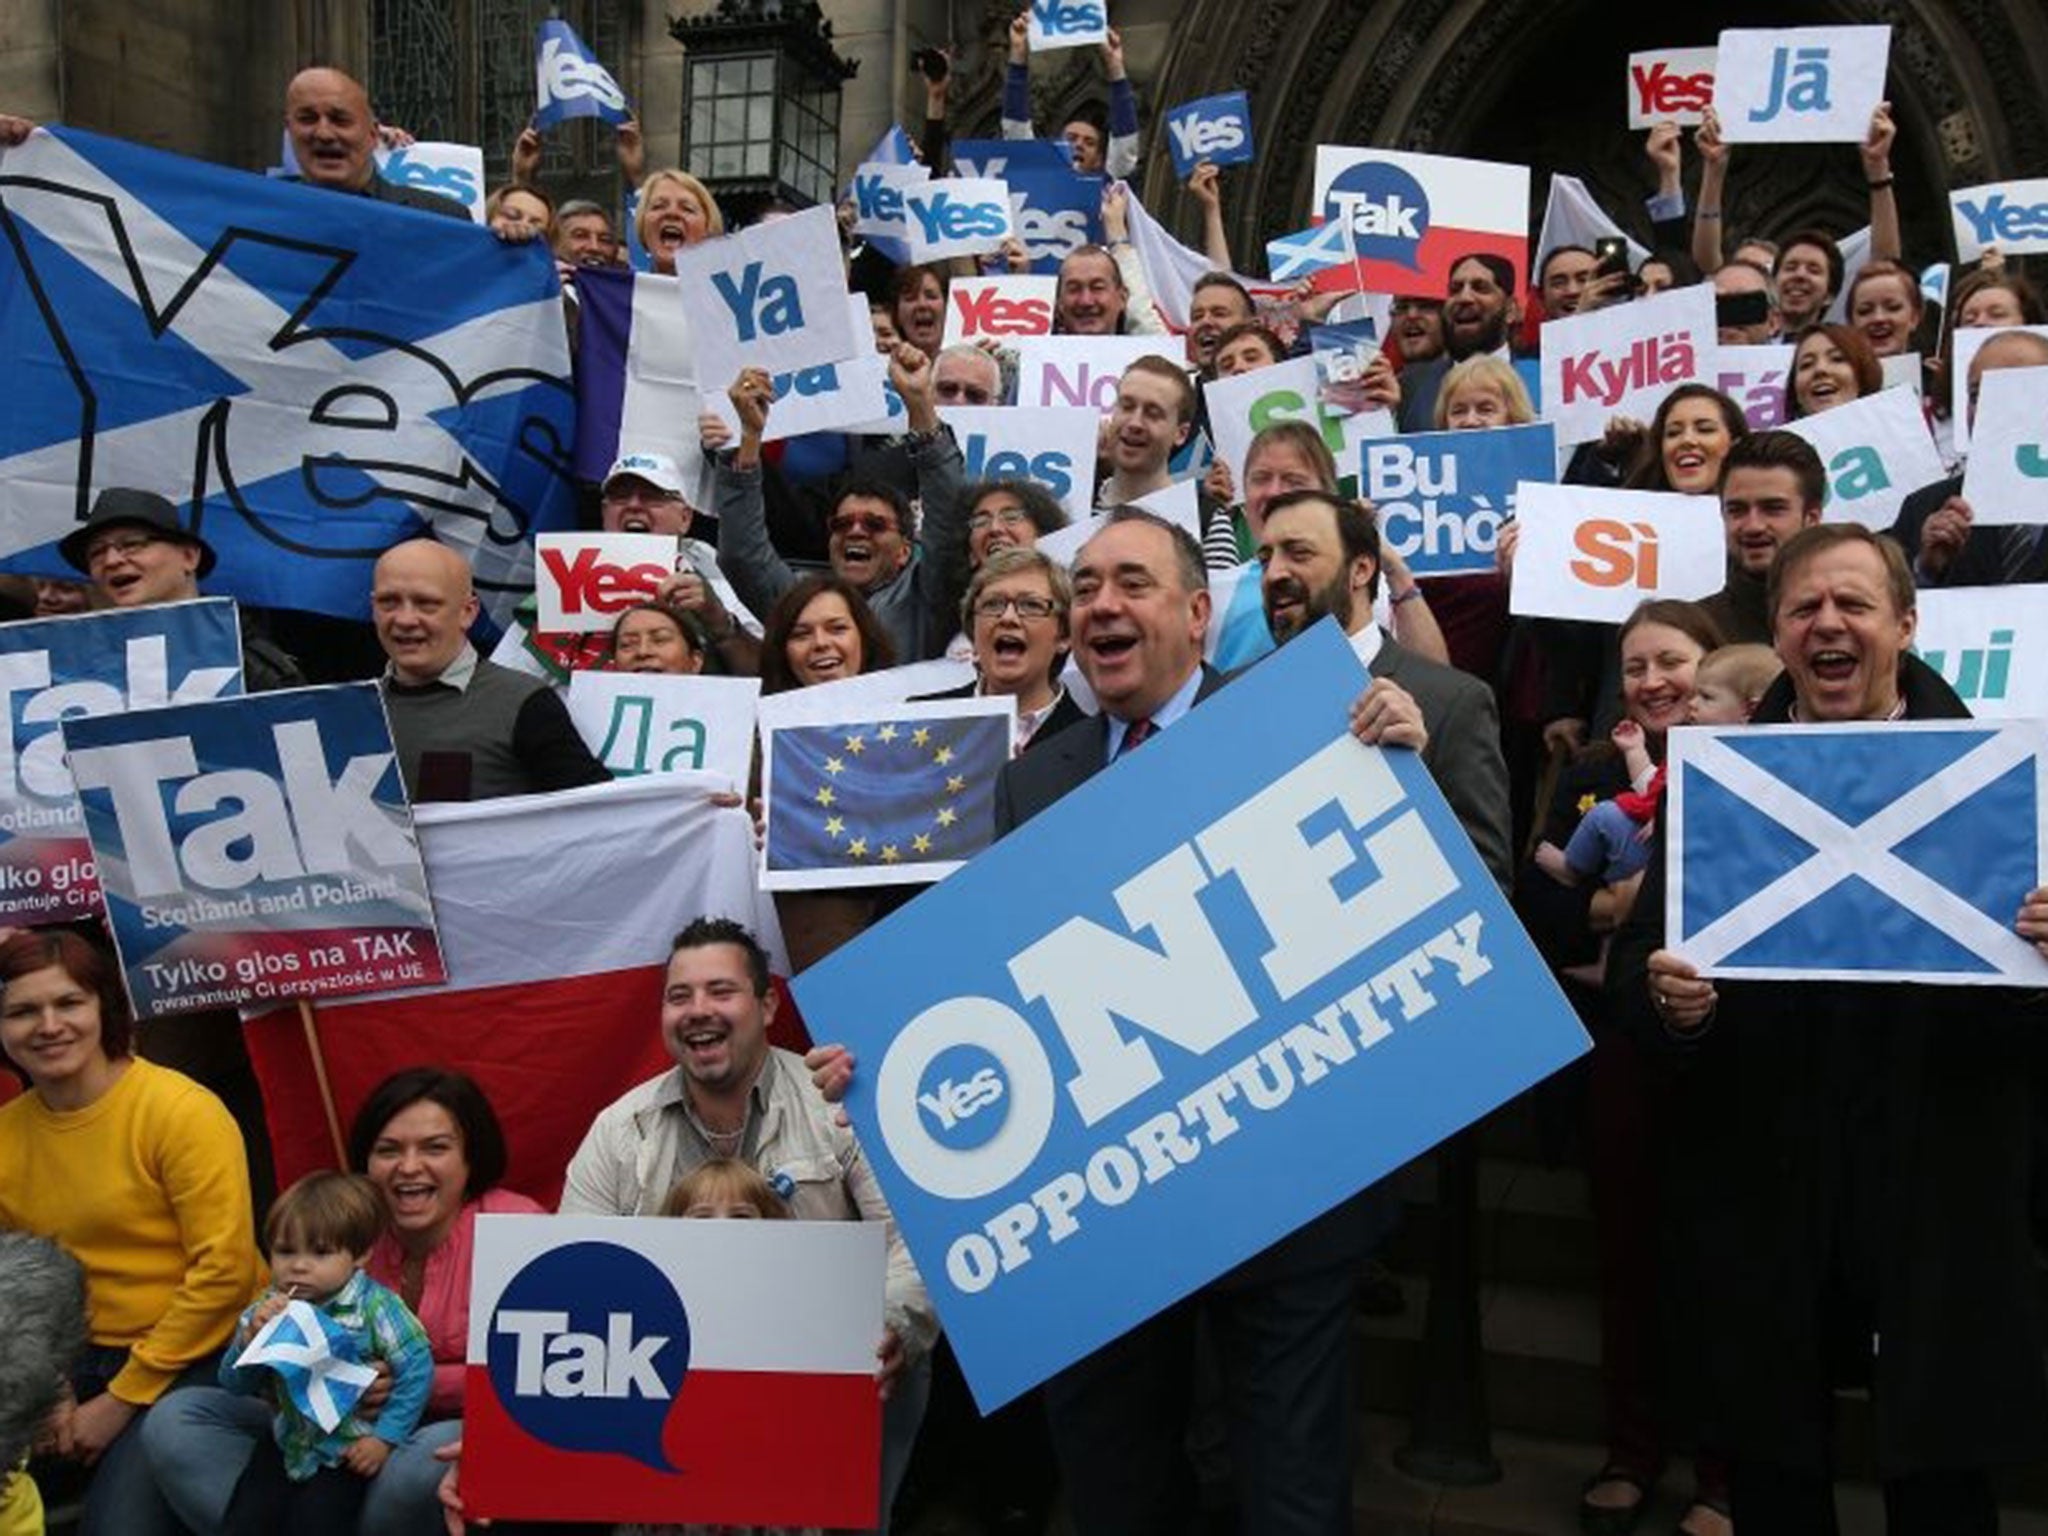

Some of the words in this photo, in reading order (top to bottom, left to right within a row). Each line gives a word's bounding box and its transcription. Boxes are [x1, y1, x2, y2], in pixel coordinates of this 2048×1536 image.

[1032, 0, 1104, 36] Yes
[1632, 62, 1715, 115] Yes
[1748, 48, 1831, 122] Jā
[1169, 112, 1245, 160] Yes
[856, 173, 906, 224] Ye
[907, 192, 1009, 244] Yes
[1329, 190, 1420, 240] Tak
[710, 261, 805, 342] Ya
[952, 286, 1052, 337] Yes
[1561, 331, 1696, 407] Kyllä
[1367, 443, 1458, 500] Bu
[1377, 493, 1517, 558] Chò
[1570, 518, 1659, 590] Sì
[1909, 629, 2015, 699] ui
[597, 696, 707, 778] Да
[68, 719, 421, 898] Tak
[141, 893, 254, 929] Scotland
[257, 884, 307, 913] and
[310, 873, 399, 907] Poland
[143, 959, 227, 993] Tylko
[308, 947, 346, 968] na
[352, 931, 417, 961] TAK
[255, 981, 276, 997] Ci
[380, 969, 394, 981] w
[397, 961, 424, 979] UE
[876, 732, 1462, 1200] ONE
[918, 1067, 1004, 1131] Yes
[945, 911, 1494, 1294] OPPORTUNITY
[496, 1310, 672, 1400] Tak
